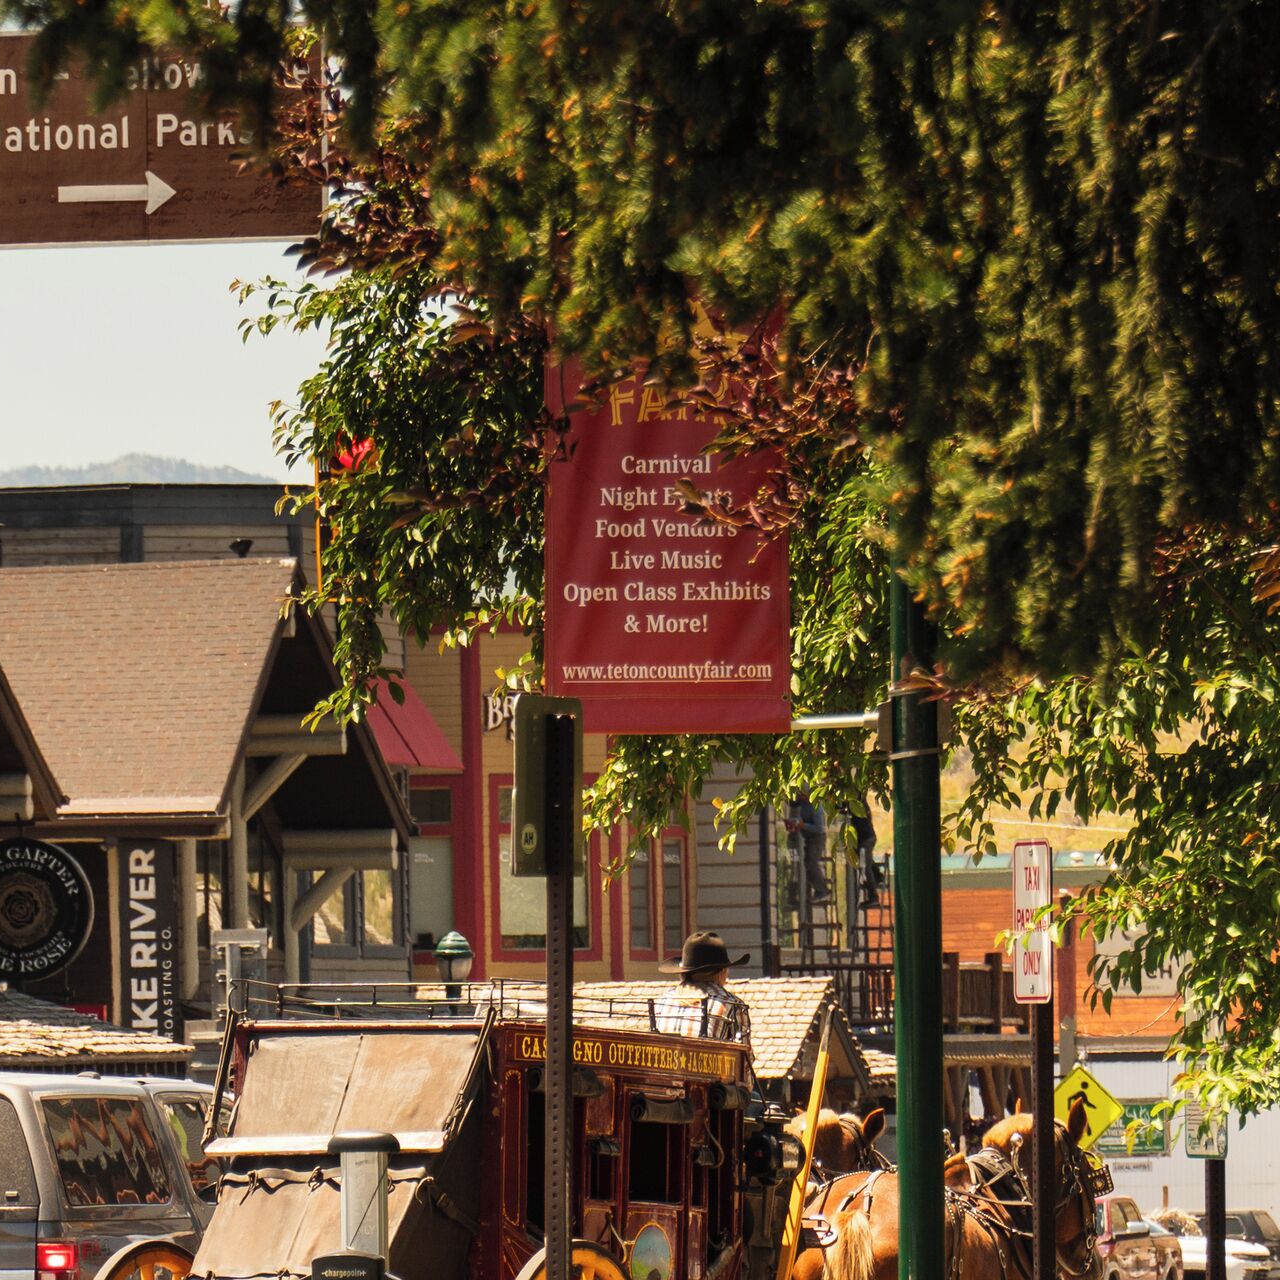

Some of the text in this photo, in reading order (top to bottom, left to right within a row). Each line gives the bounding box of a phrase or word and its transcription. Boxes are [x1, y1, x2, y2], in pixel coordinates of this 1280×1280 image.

[621, 455, 711, 474] Carnival
[600, 488, 656, 510] Night
[595, 519, 737, 538] Food Vendors
[610, 550, 722, 570] Live Music
[563, 581, 771, 606] Open Class Exhibits
[624, 613, 708, 633] & More!
[563, 660, 772, 683] www.tetoncountyfair.com
[6, 847, 79, 895] GARTER
[1024, 866, 1040, 891] TAXI
[129, 849, 157, 968] RIVER
[20, 938, 72, 973] ROSE
[1023, 951, 1041, 976] ONLY
[161, 926, 174, 1039] ROASTING CO.
[522, 1036, 602, 1063] CASGNO
[609, 1042, 679, 1070] OUTFITTERS
[687, 1051, 722, 1074] JACKSON
